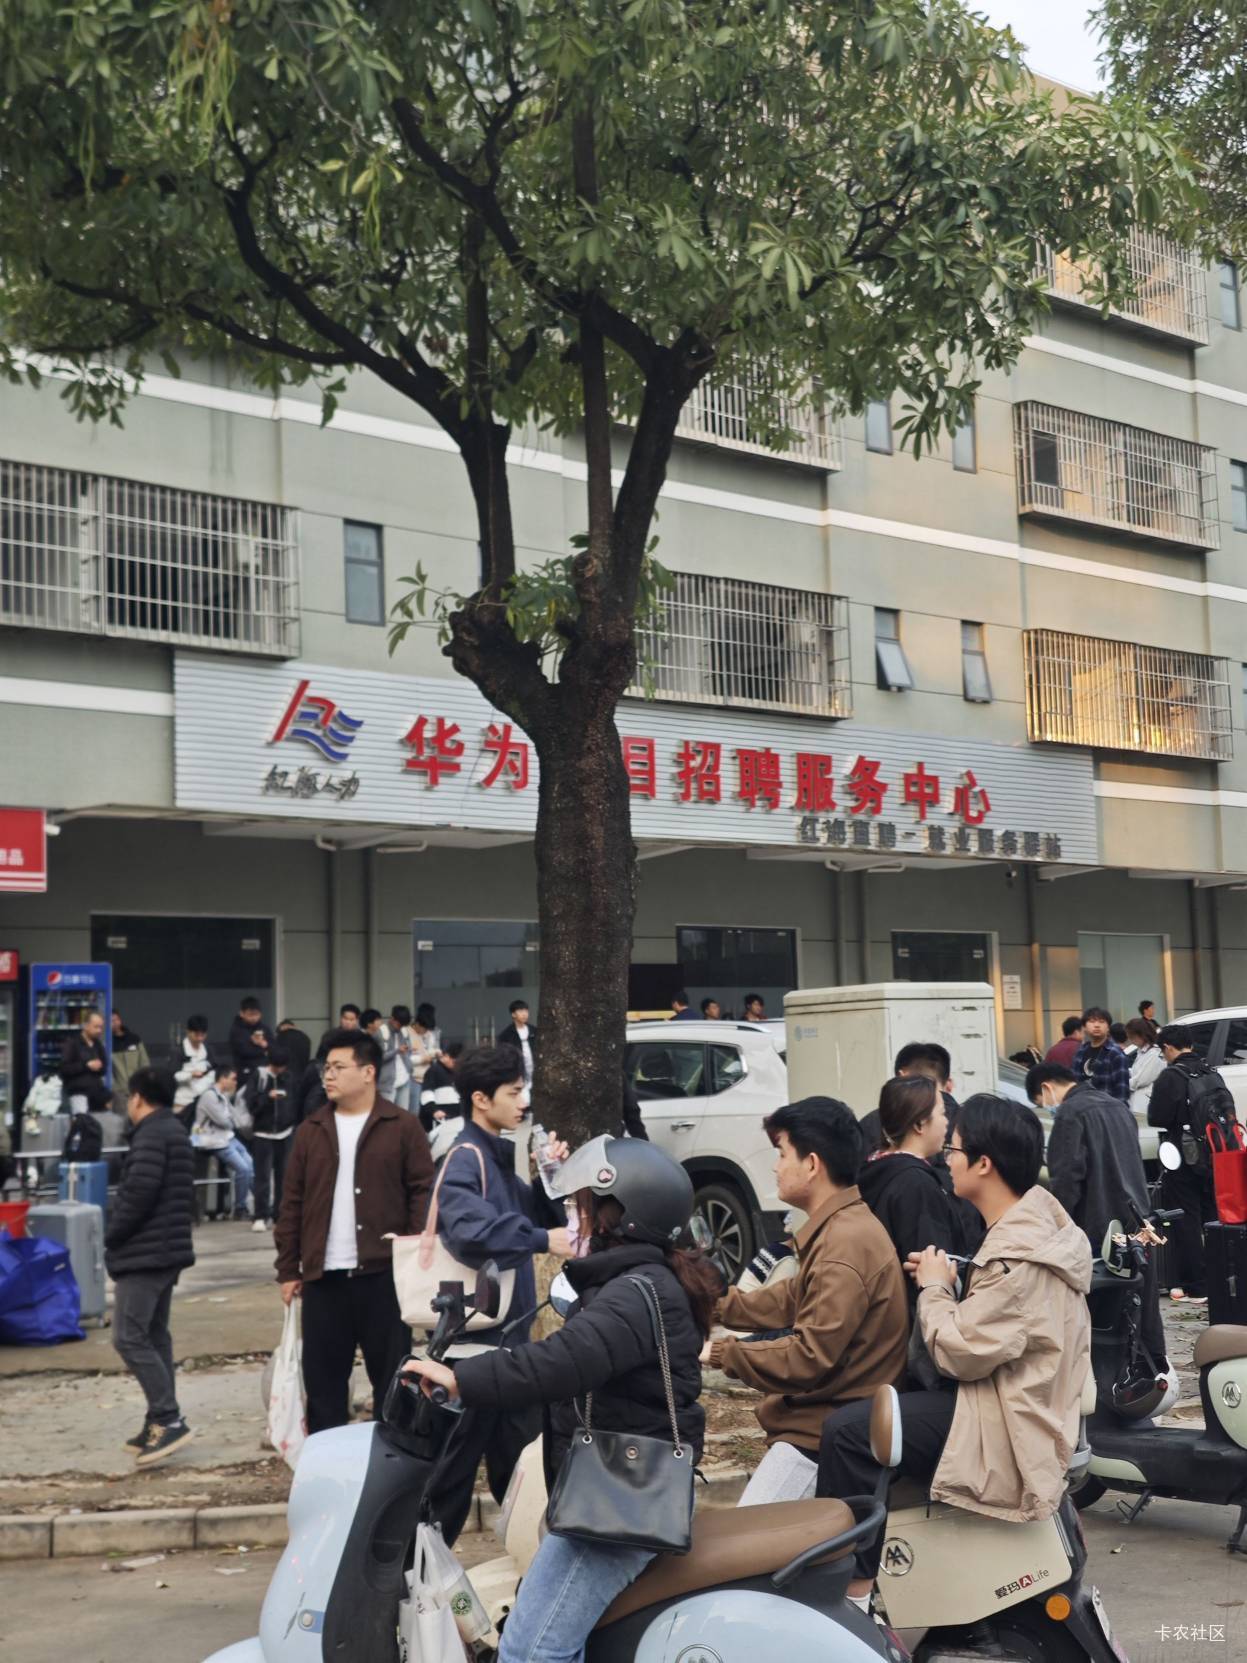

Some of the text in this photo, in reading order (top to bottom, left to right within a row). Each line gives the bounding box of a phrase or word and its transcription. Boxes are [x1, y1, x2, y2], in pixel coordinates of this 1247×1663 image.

[405, 714, 992, 825] 华为目招聘服务中心
